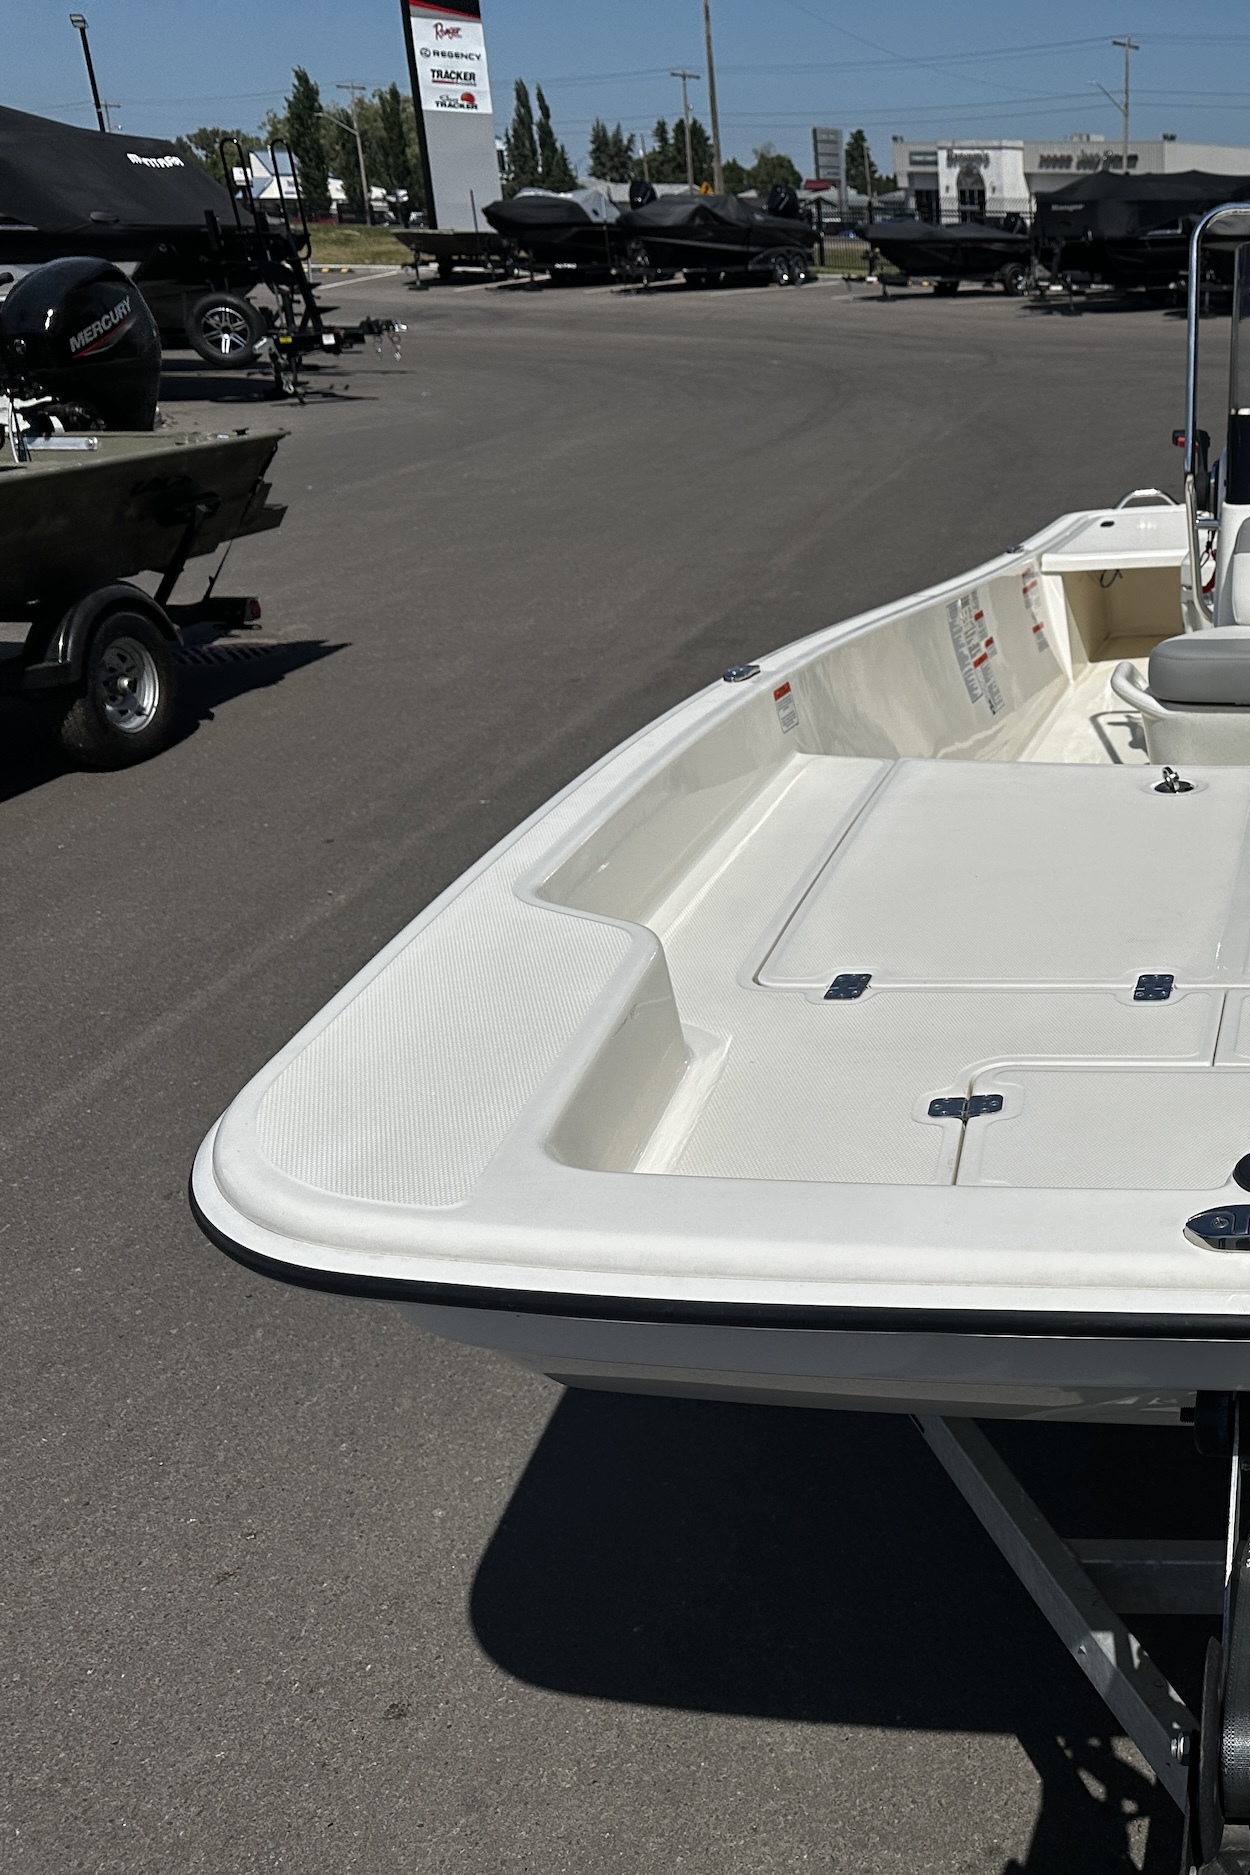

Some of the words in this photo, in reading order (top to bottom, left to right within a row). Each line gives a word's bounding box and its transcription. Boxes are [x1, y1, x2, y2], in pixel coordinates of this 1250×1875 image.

[432, 49, 481, 61] REGENCY
[430, 68, 476, 82] TRACKER
[435, 101, 478, 110] TRACKER
[69, 295, 132, 353] MERCURY
